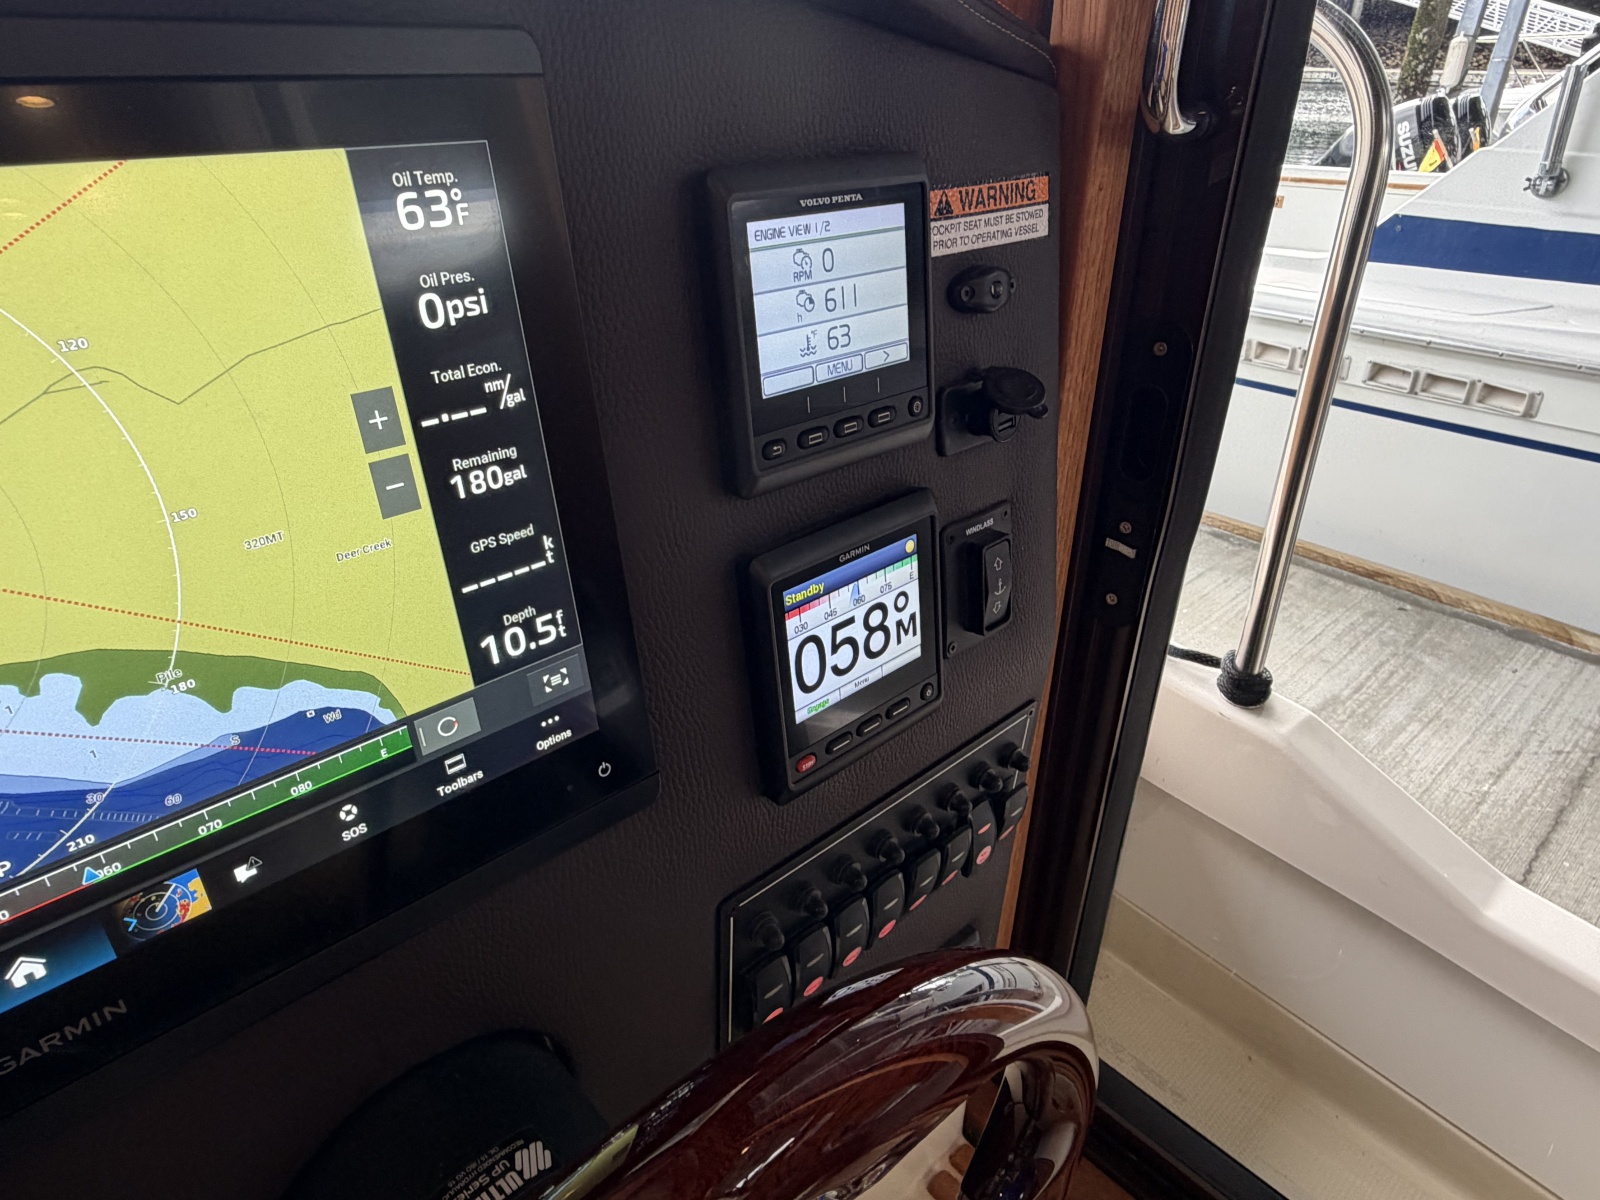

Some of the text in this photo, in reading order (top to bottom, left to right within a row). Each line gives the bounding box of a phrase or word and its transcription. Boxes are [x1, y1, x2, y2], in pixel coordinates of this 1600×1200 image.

[392, 170, 459, 187] Oil Temp.
[799, 193, 864, 208] VOLVO PENTA
[958, 180, 1036, 212] WARNING
[963, 219, 983, 231] SEAT
[984, 215, 1004, 228] MUST
[1005, 214, 1015, 224] BE
[1015, 208, 1044, 223] STOWED
[754, 226, 786, 242] ENGINE
[788, 223, 812, 237] VIEW
[933, 223, 1040, 251] PRIOR TO OPERATING VESSEL
[822, 247, 835, 273] 0
[419, 270, 475, 289] Oil Pres.
[793, 270, 813, 283] RPM
[824, 283, 858, 312] 611
[57, 337, 90, 353] 120
[827, 324, 851, 350] 63
[430, 361, 503, 385] Total Econ.
[827, 360, 853, 377] MENU
[452, 446, 518, 471] Remaining
[171, 508, 198, 523] 150
[965, 517, 994, 537] WINDLASS
[243, 531, 285, 550] 320MT
[470, 523, 535, 554] GPS Speed
[336, 538, 392, 562] Deer Creek
[838, 543, 871, 563] GARMIN
[785, 582, 825, 606] Standby
[793, 621, 809, 634] 030
[823, 608, 838, 621] 045
[879, 581, 893, 594] 075
[909, 571, 915, 580] E
[503, 605, 537, 626] Depth
[156, 668, 182, 684] Pile
[170, 678, 196, 694] 180
[536, 728, 572, 751] Options
[380, 748, 388, 758] E
[290, 780, 313, 796] 080
[436, 769, 484, 798] Toolbars
[85, 792, 105, 805] 30
[164, 793, 182, 806] 60
[197, 818, 223, 835] 070
[341, 822, 368, 841] SOS
[66, 834, 96, 852] 210
[0, 999, 127, 1076] GARMIN
[491, 1160, 510, 1177] UP
